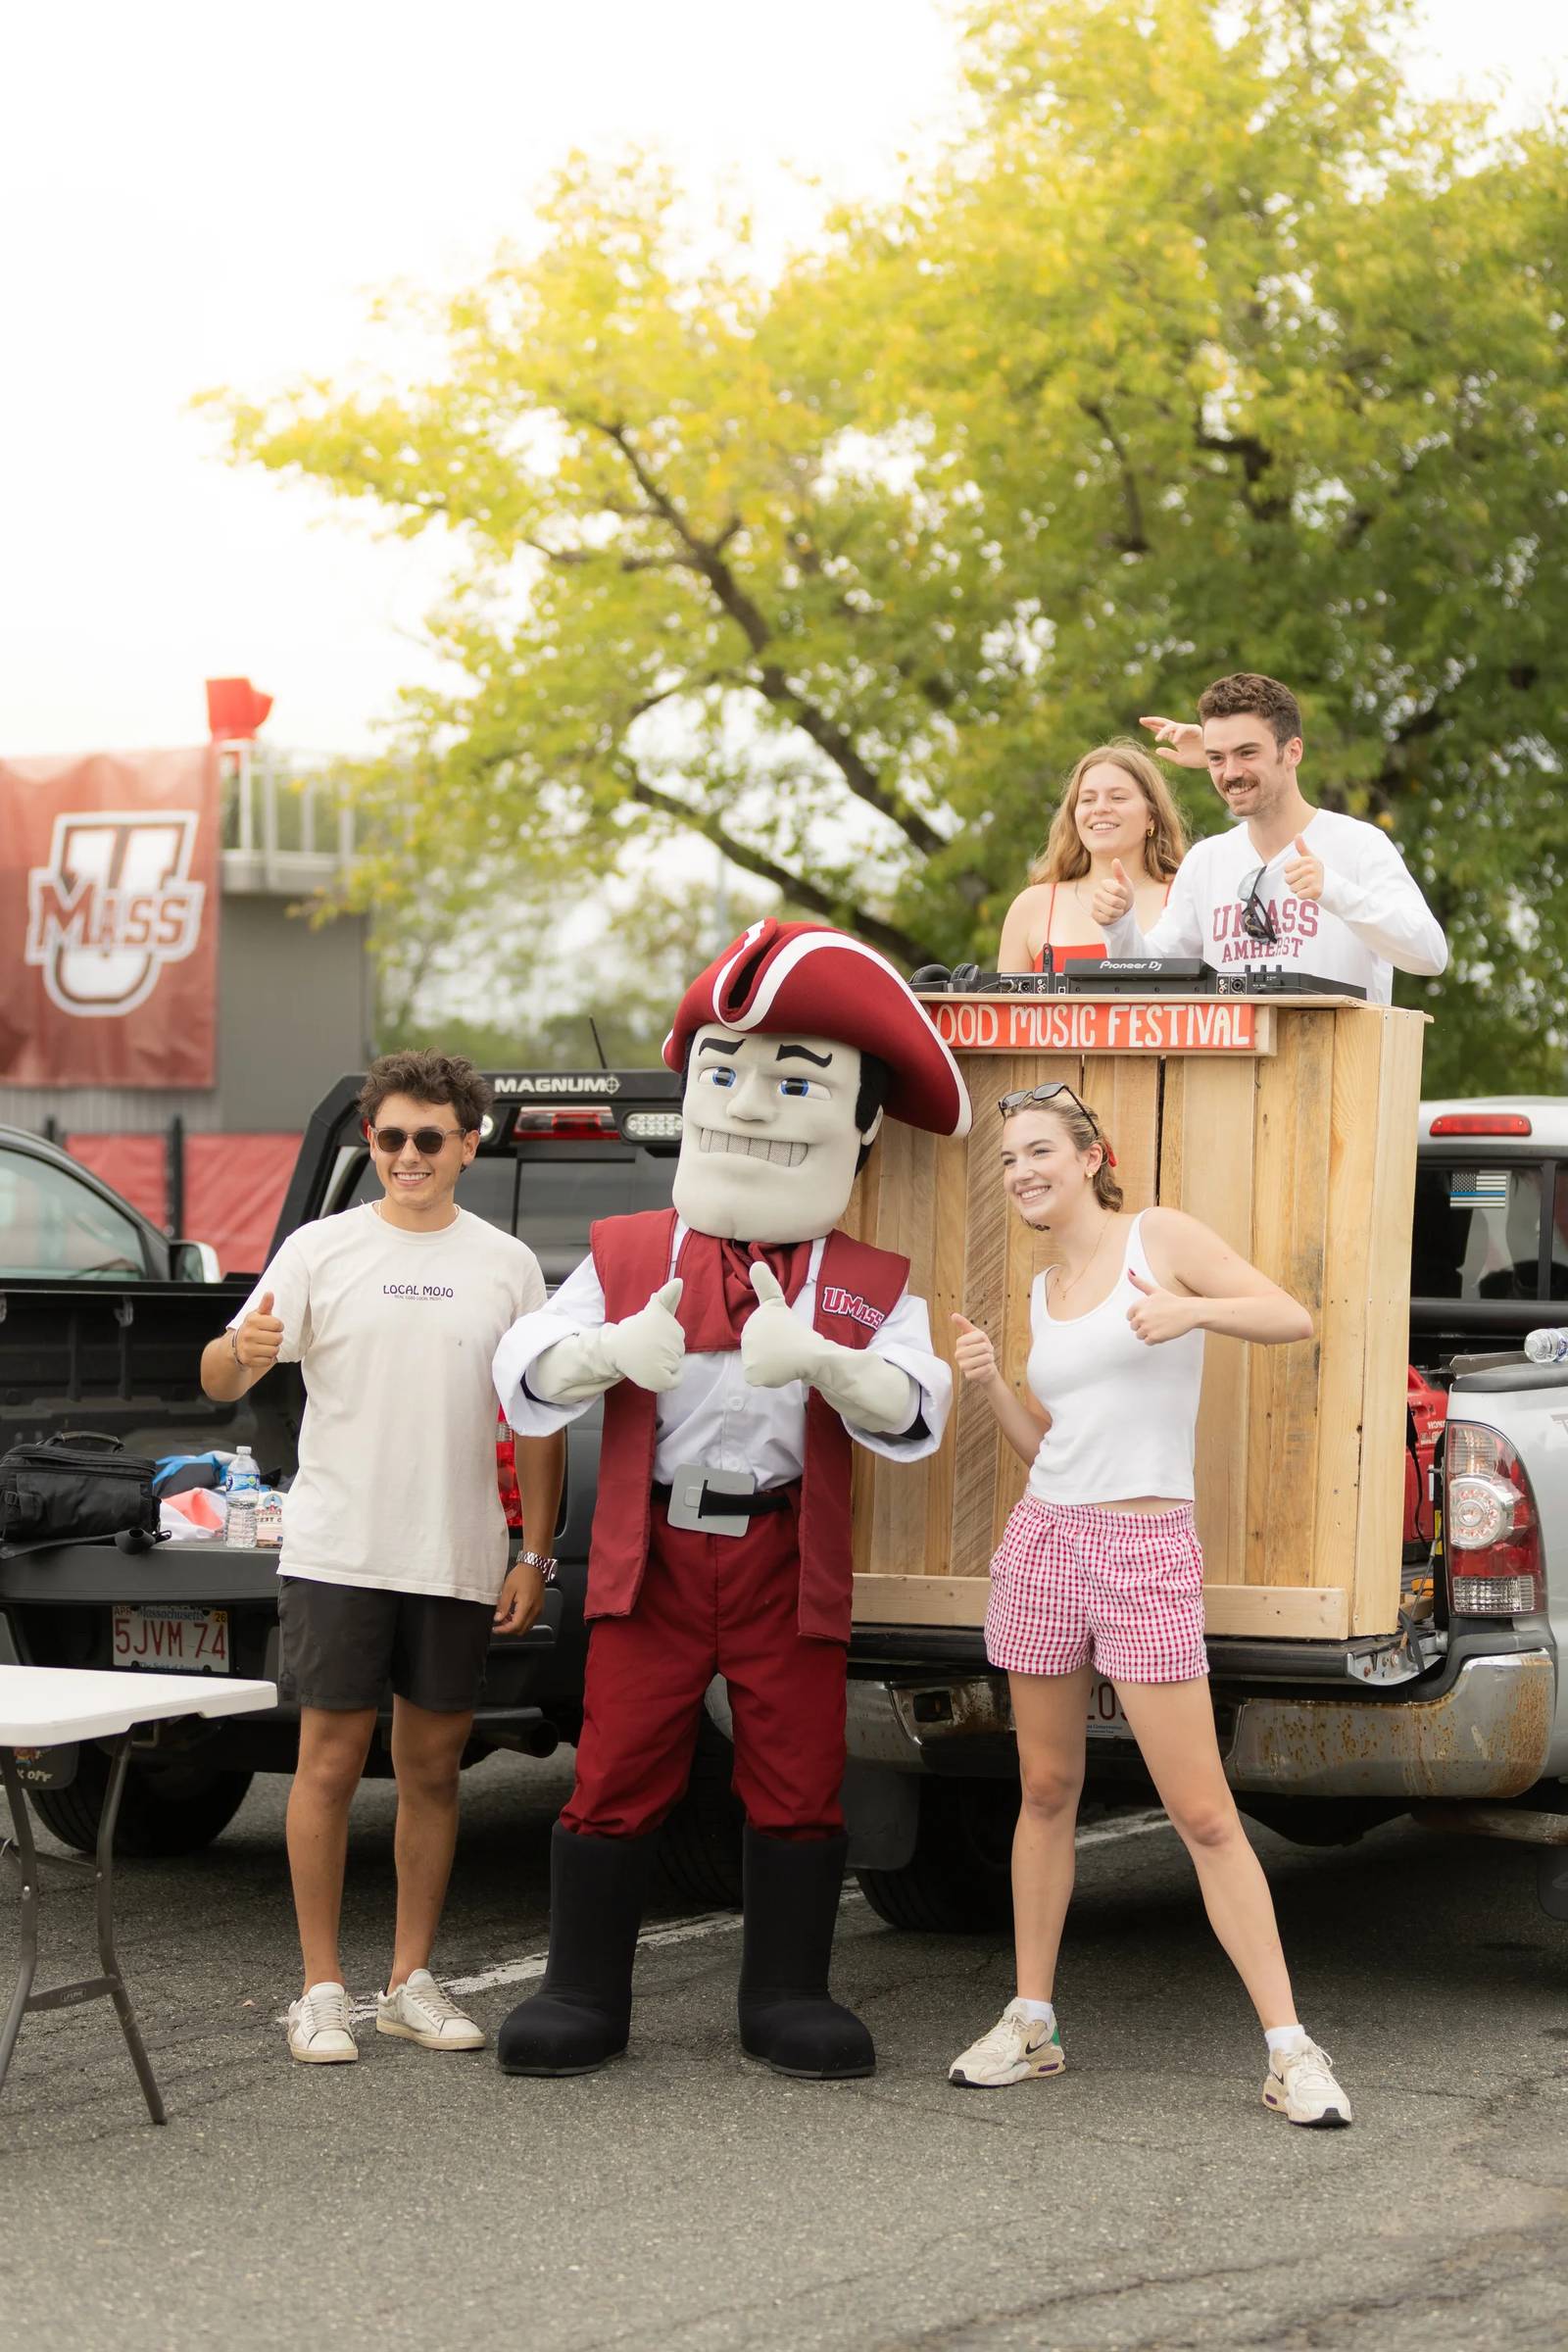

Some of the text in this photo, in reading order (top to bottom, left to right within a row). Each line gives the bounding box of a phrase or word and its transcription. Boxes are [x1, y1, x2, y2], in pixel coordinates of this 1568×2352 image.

[925, 1004, 1250, 1048] OOD MUSIC FESTIVAL
[494, 1077, 607, 1093] MAGNUM
[383, 1284, 454, 1298] LOCAL MOJO
[215, 1612, 226, 1623] 26
[115, 1619, 225, 1660] 5JVM 74
